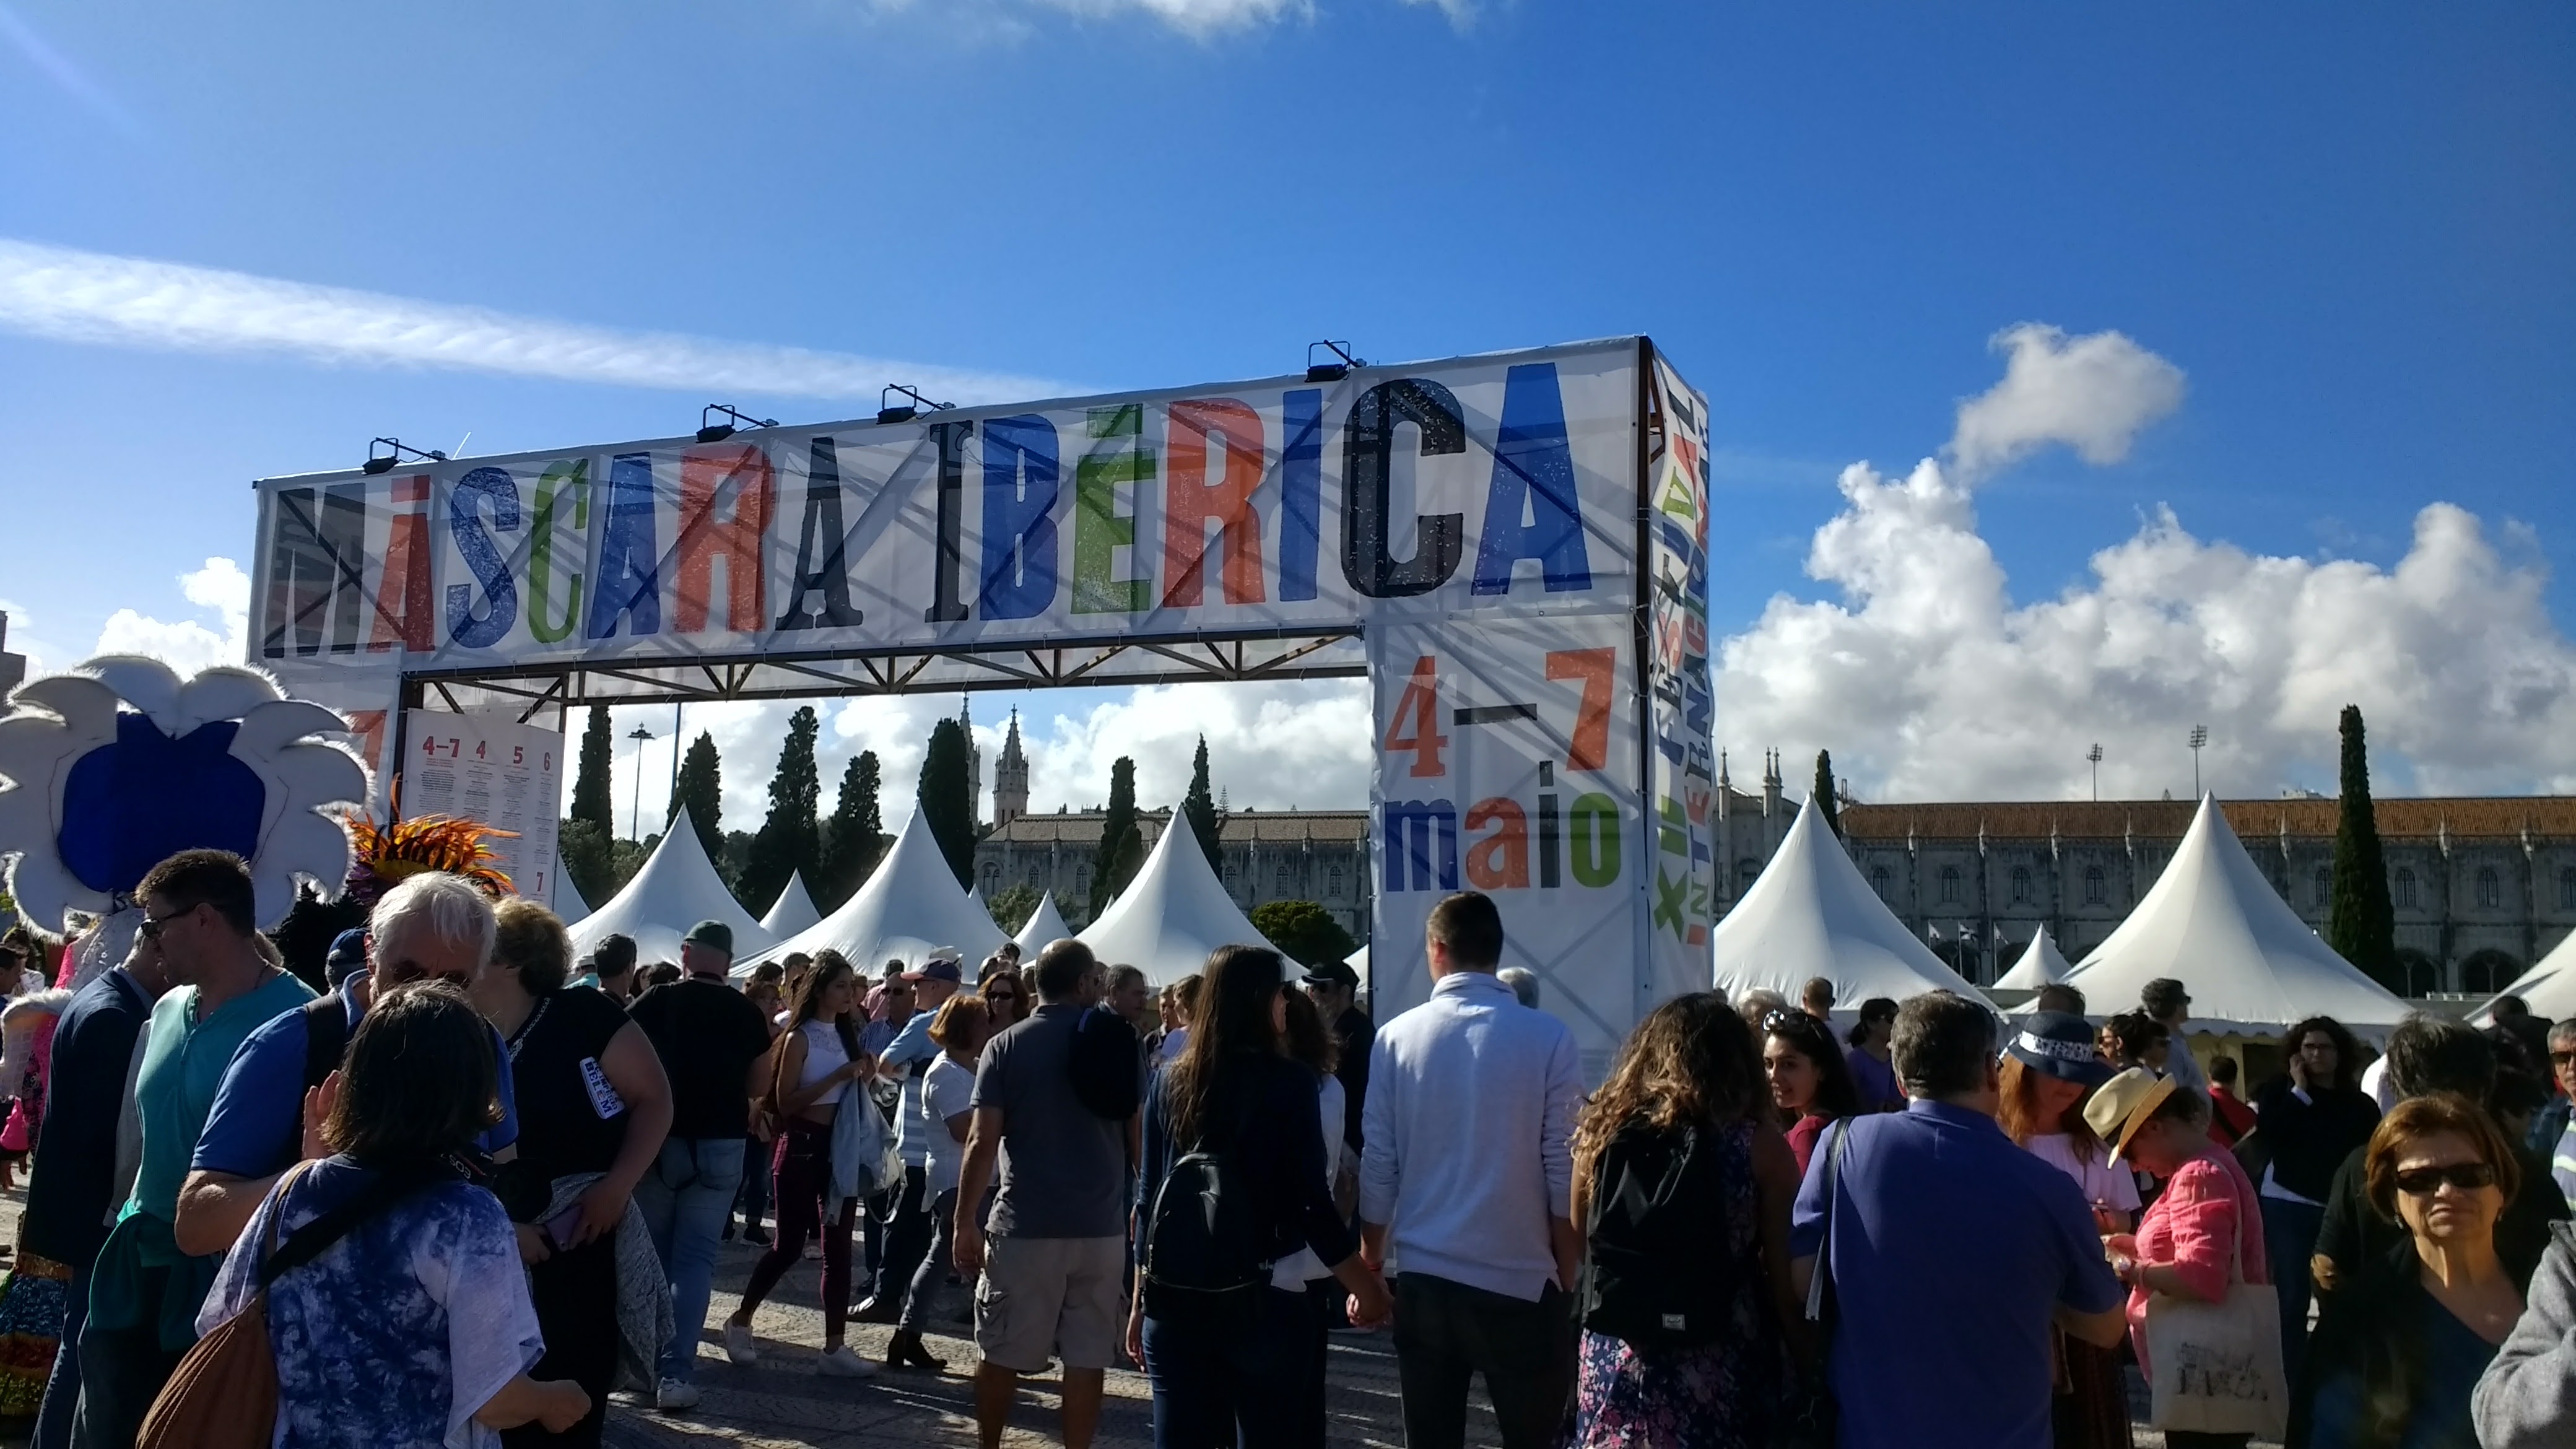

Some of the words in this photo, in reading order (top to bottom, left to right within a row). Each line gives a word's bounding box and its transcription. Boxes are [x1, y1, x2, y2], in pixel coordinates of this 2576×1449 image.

[264, 437, 863, 658] MÁSCARA
[926, 362, 1592, 623] IBÉRICA
[1653, 389, 1697, 767] FESTIVAL
[476, 741, 485, 759] 4
[513, 746, 523, 764] 5
[544, 752, 550, 771] 6
[1385, 761, 1621, 892] maio
[1653, 794, 1688, 942] XII
[537, 871, 543, 892] 7
[449, 1154, 471, 1179] EOS
